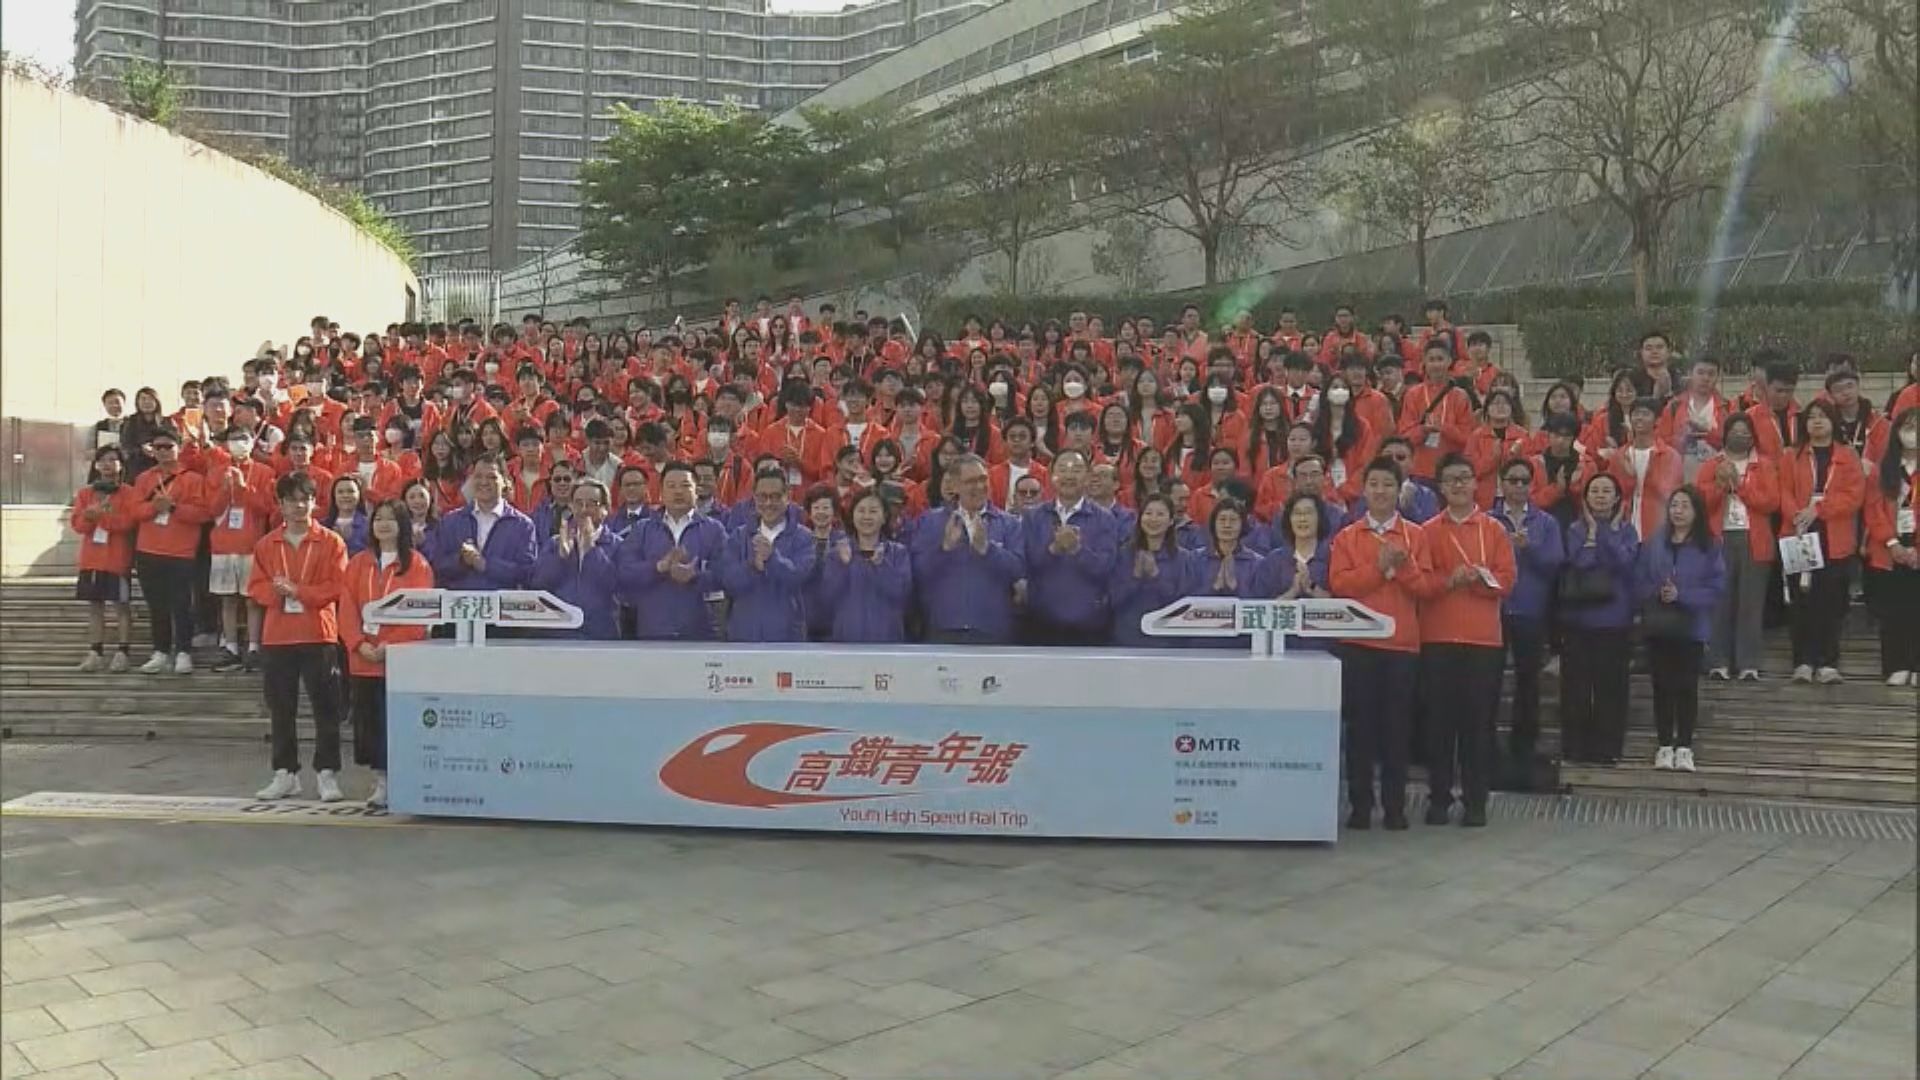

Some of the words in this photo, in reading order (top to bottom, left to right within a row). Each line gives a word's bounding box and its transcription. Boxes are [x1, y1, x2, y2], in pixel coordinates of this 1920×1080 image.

[450, 595, 492, 619] 香港
[1241, 605, 1297, 631] 武漢
[1198, 738, 1241, 751] MTR
[785, 731, 1028, 791] 高鐵青年號
[839, 808, 880, 821] Youth
[885, 809, 916, 825] High
[920, 810, 966, 826] Speed
[969, 811, 996, 825] Rail
[1000, 812, 1029, 827] Trip
